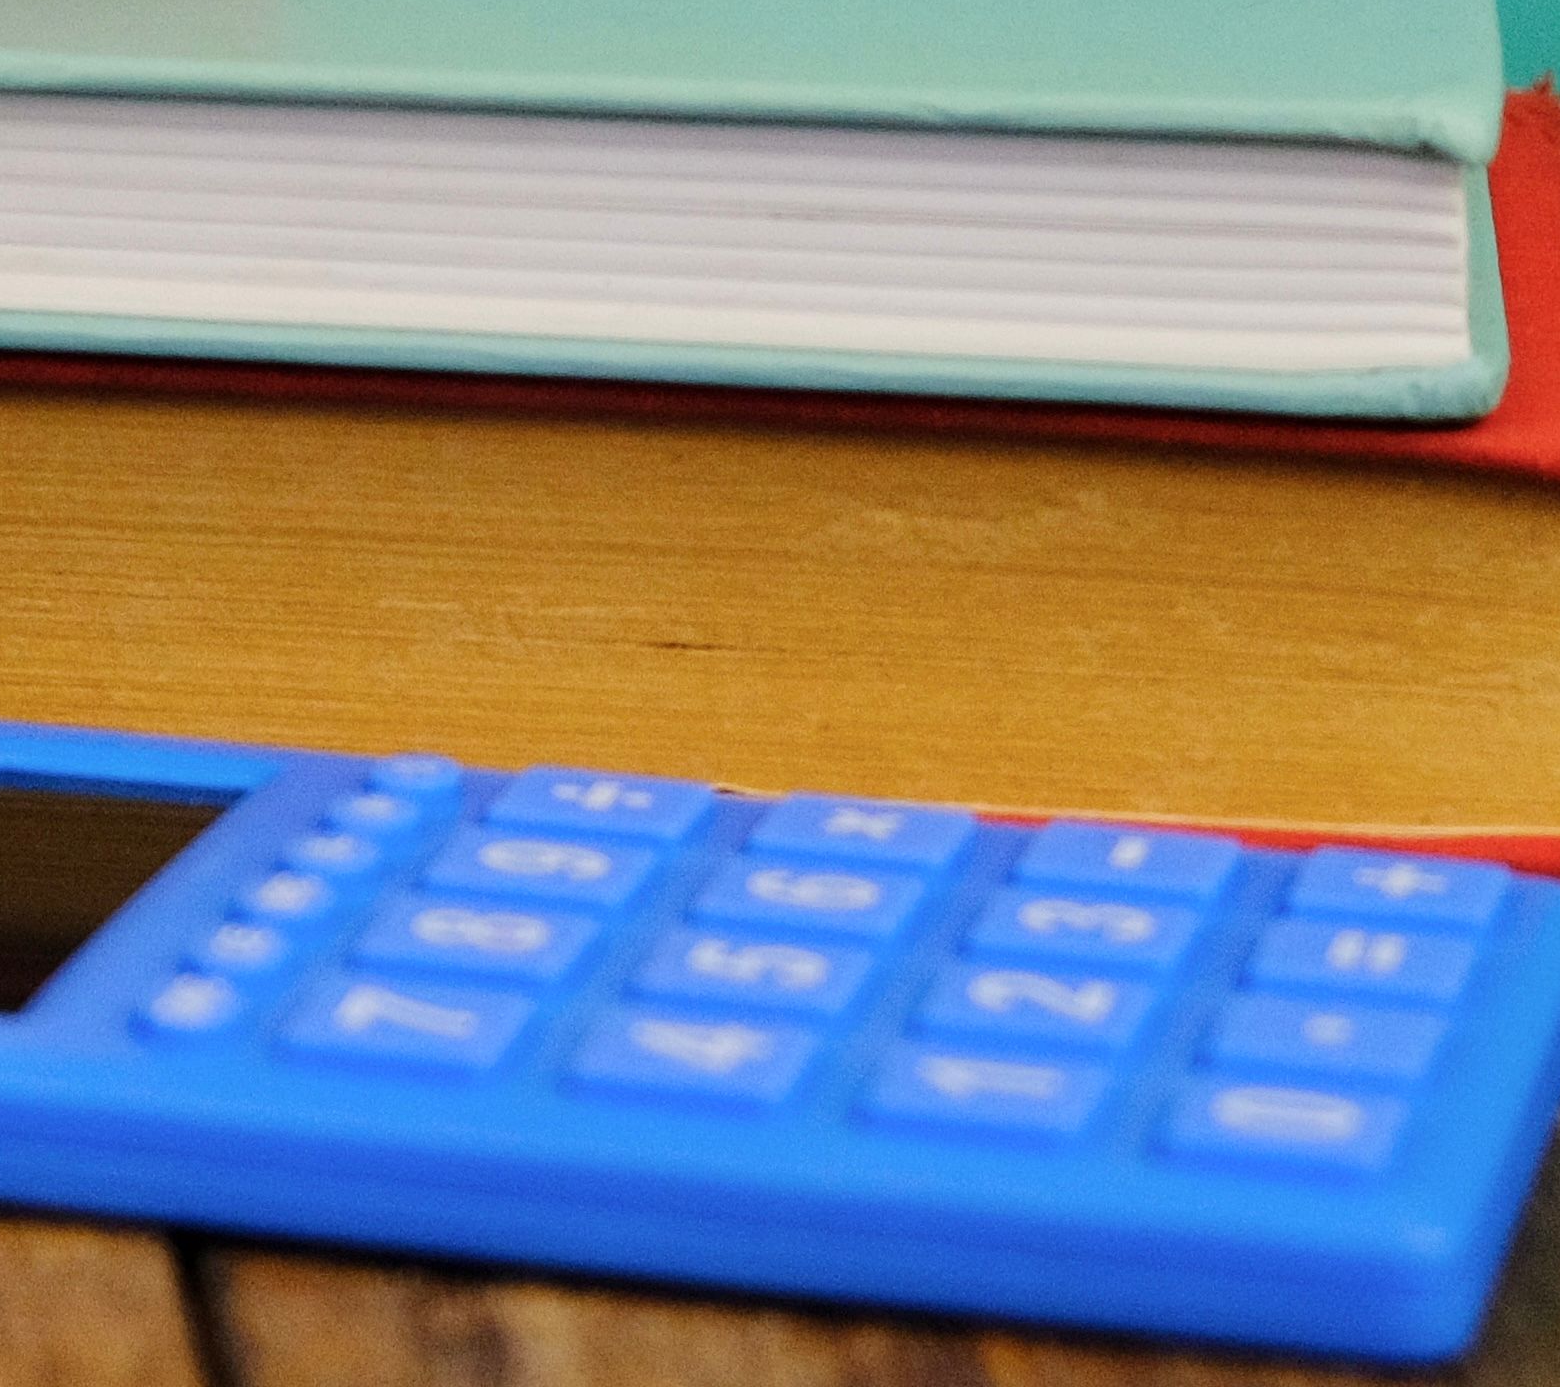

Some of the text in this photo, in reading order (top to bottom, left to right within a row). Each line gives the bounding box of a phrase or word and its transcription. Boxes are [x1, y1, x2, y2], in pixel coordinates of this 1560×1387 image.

[477, 838, 613, 881] 9
[744, 868, 882, 912] 6
[410, 905, 550, 953] 8
[1017, 897, 1155, 943] 3
[685, 936, 830, 990] 5
[333, 984, 480, 1040] 7
[966, 969, 1116, 1022] 2
[630, 1018, 774, 1072] 4
[916, 1053, 1064, 1101] 1
[1210, 1085, 1363, 1141] 0
